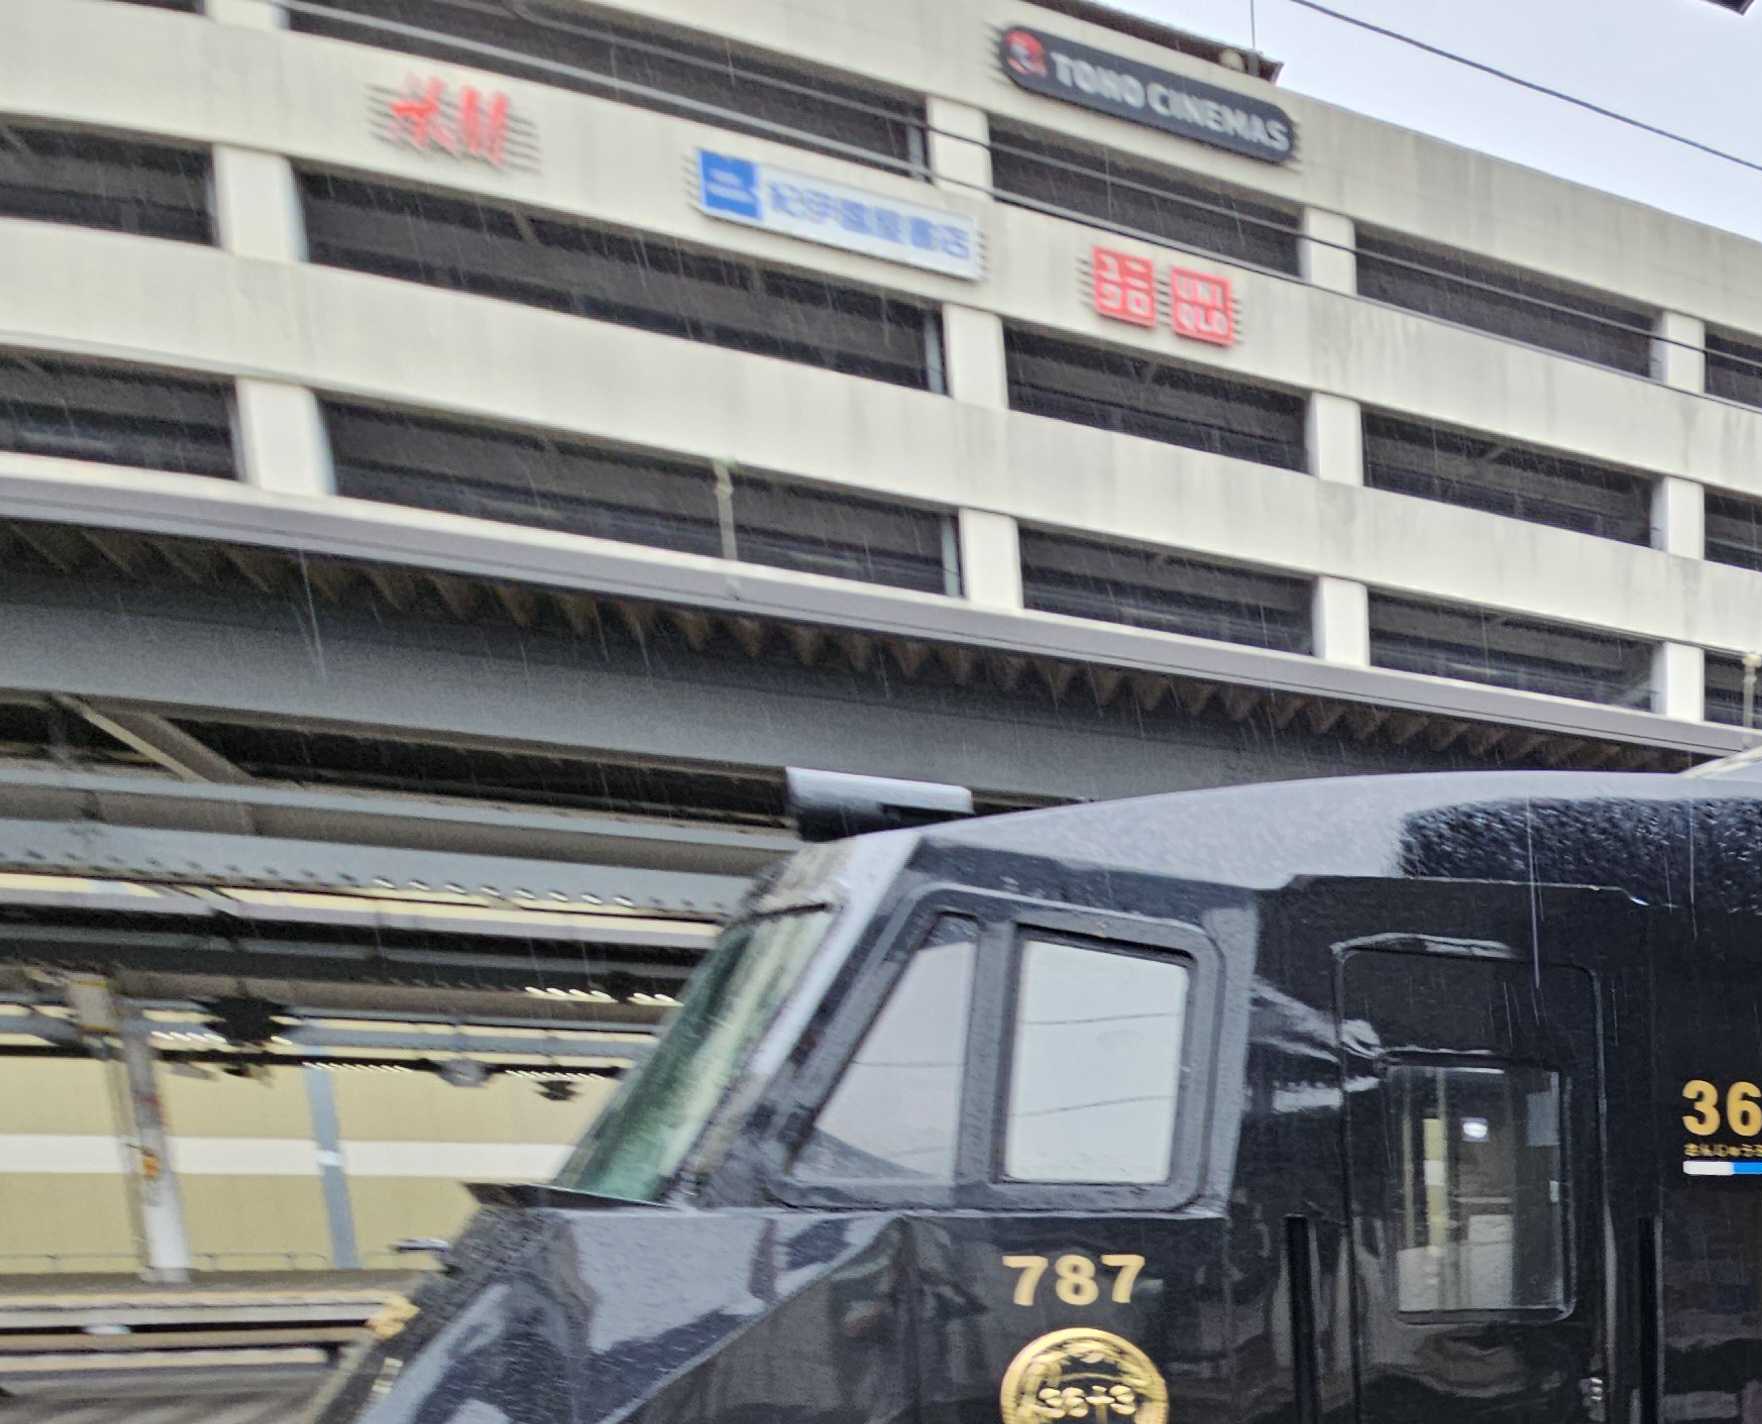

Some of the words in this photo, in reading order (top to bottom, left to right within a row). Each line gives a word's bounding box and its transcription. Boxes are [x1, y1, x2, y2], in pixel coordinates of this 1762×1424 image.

[1050, 52, 1146, 108] TOHO
[1147, 82, 1291, 152] CINEMAS
[1002, 1254, 1146, 1307] 787
